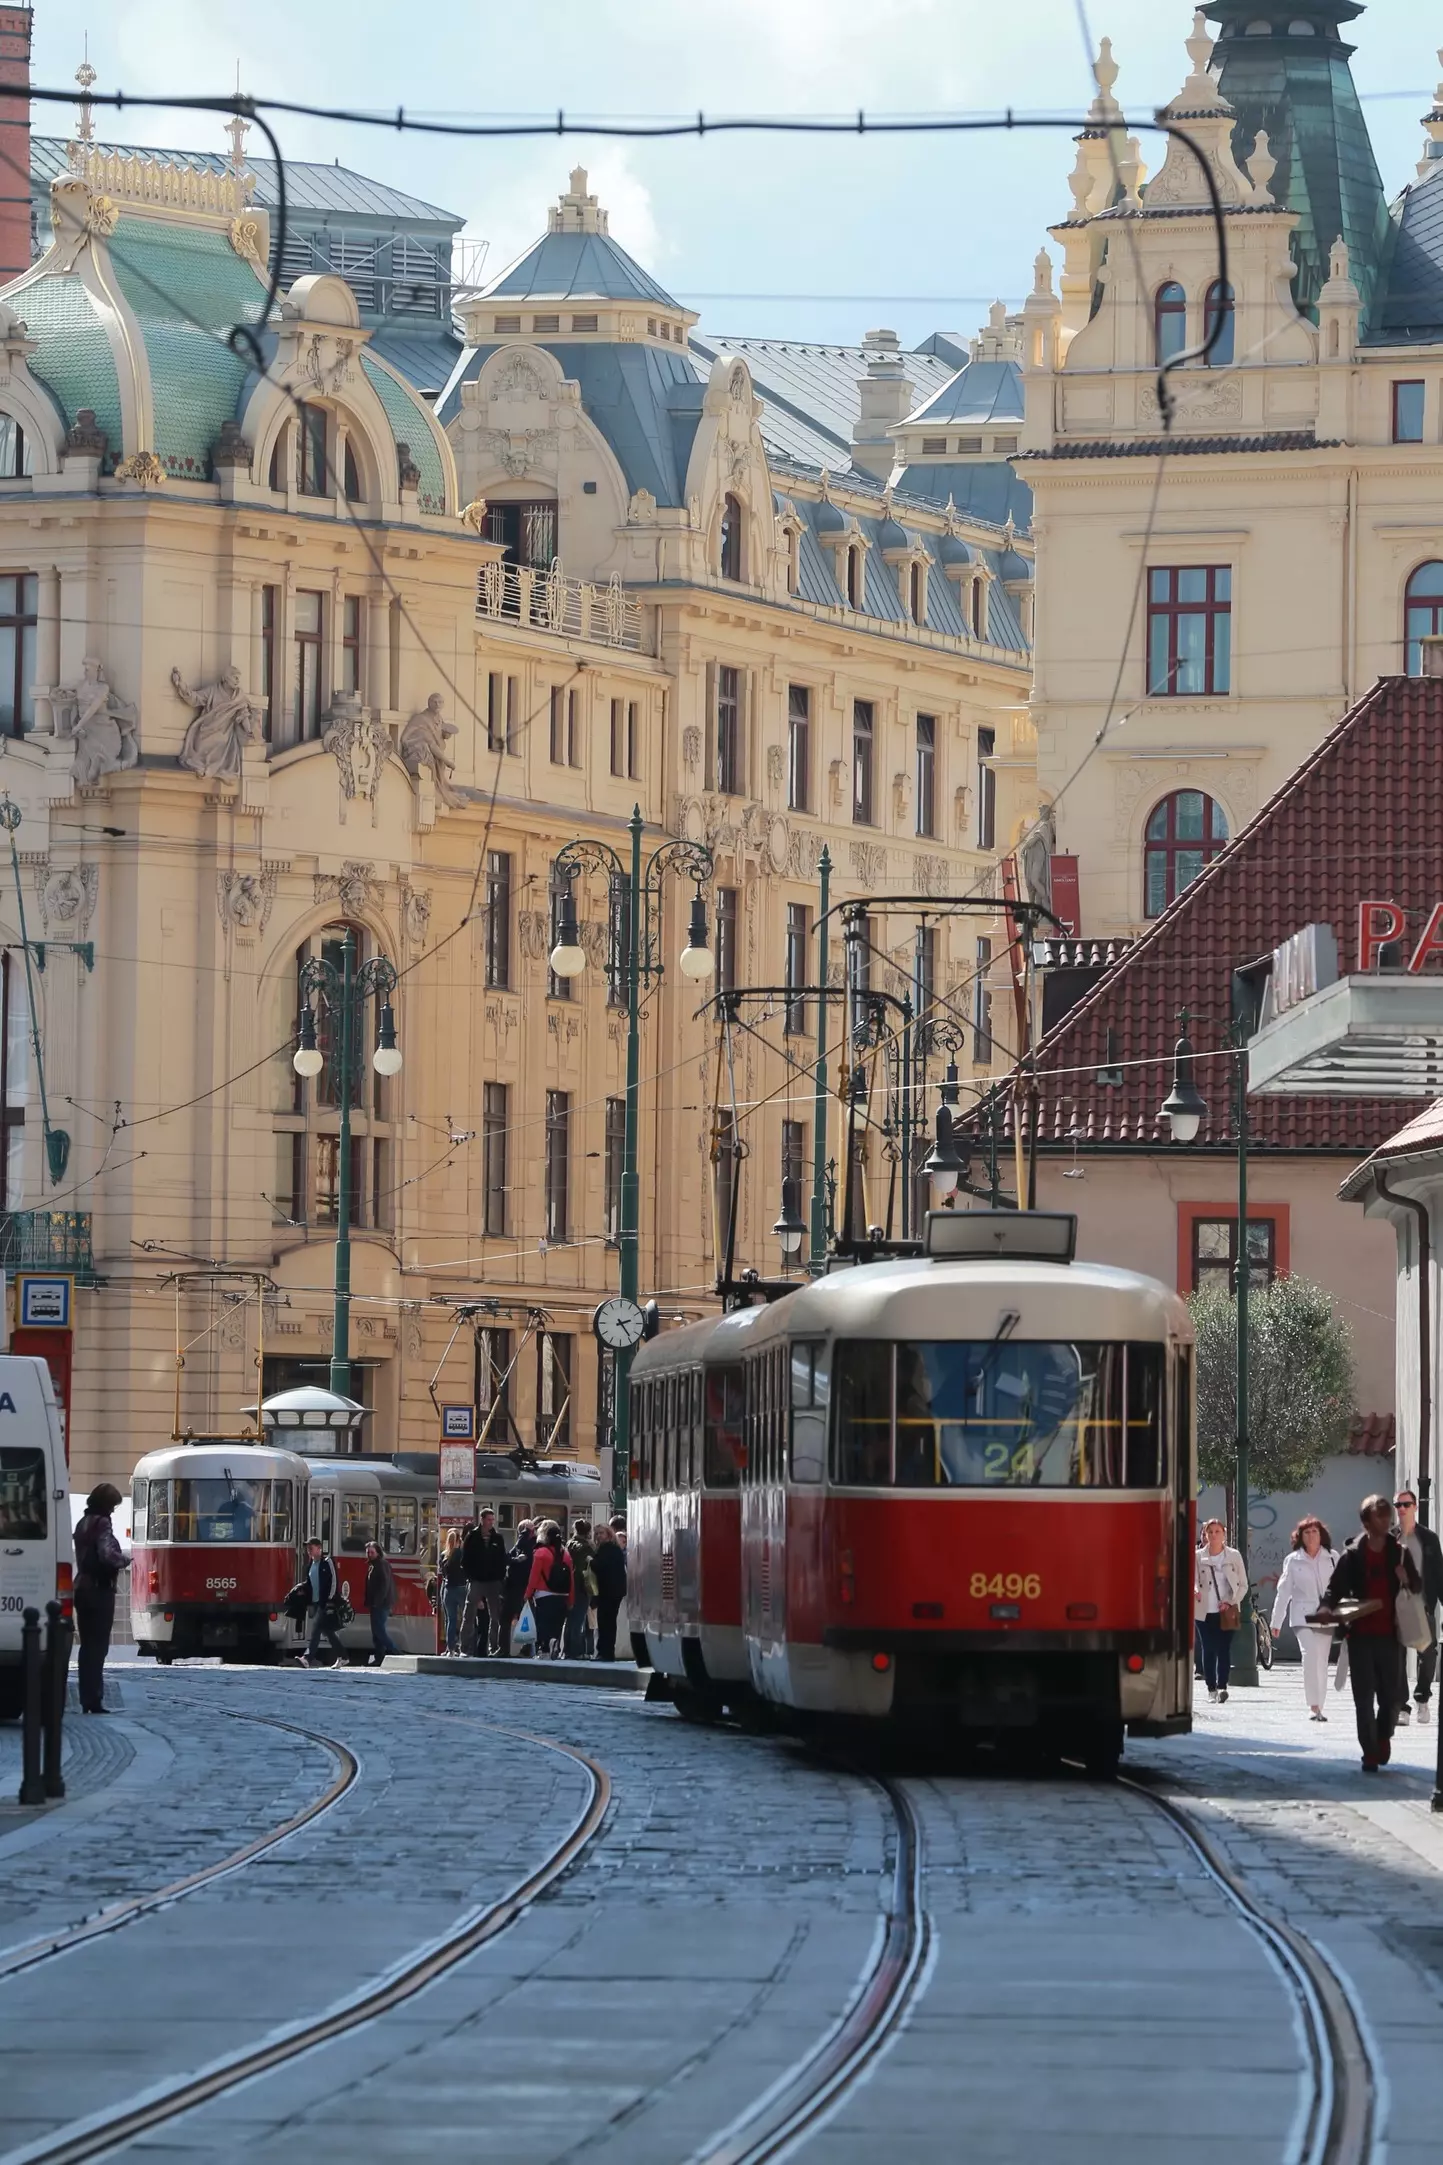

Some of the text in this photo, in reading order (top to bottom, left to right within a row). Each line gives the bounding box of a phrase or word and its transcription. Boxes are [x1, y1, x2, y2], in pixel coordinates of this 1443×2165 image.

[984, 1442, 1036, 1480] 24
[205, 1577, 238, 1589] 8565
[969, 1572, 1042, 1599] 8496
[0, 1596, 24, 1612] 300
